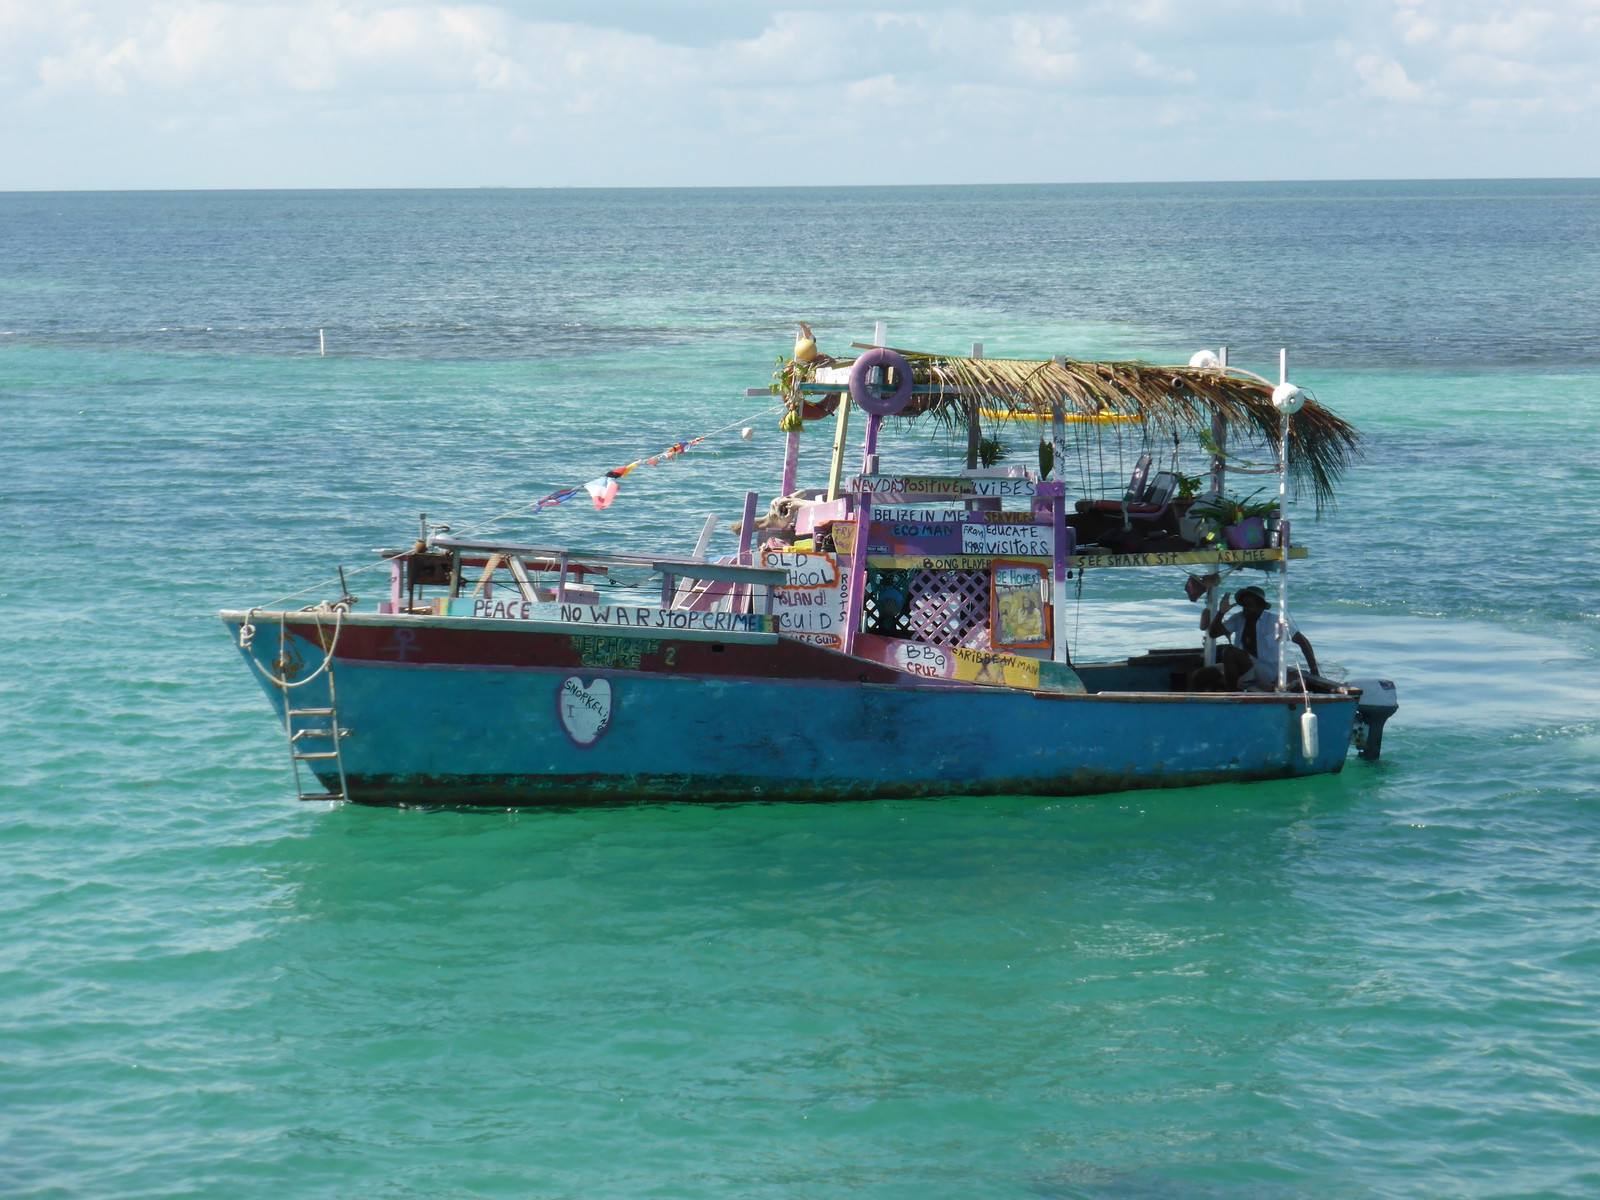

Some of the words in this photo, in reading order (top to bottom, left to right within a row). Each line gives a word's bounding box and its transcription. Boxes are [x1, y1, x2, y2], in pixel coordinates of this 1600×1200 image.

[979, 480, 1035, 496] ViBES
[874, 509, 915, 522] BELIZE
[920, 510, 935, 522] IN
[983, 511, 1036, 524] SERVICES
[893, 524, 919, 537] ECO
[921, 525, 954, 536] MAN
[964, 540, 984, 554] 1989
[766, 552, 808, 568] OLD
[1075, 555, 1102, 568] SEE
[1107, 554, 1150, 567] SHARK
[1217, 550, 1240, 563] ASK
[1242, 549, 1266, 562] MEE
[961, 558, 992, 570] PLAYER
[996, 571, 1008, 584] BE
[1009, 570, 1042, 585] HONESt
[838, 573, 849, 622] ROOTS
[473, 599, 532, 620] PEACE
[560, 604, 583, 623] NO
[589, 605, 651, 627] WAR
[655, 609, 699, 630] StOP
[702, 611, 757, 633] CRIME
[663, 646, 677, 667] 2
[906, 644, 946, 670] BBQ
[906, 661, 939, 678] CRUZ
[1017, 661, 1038, 676] MAN
